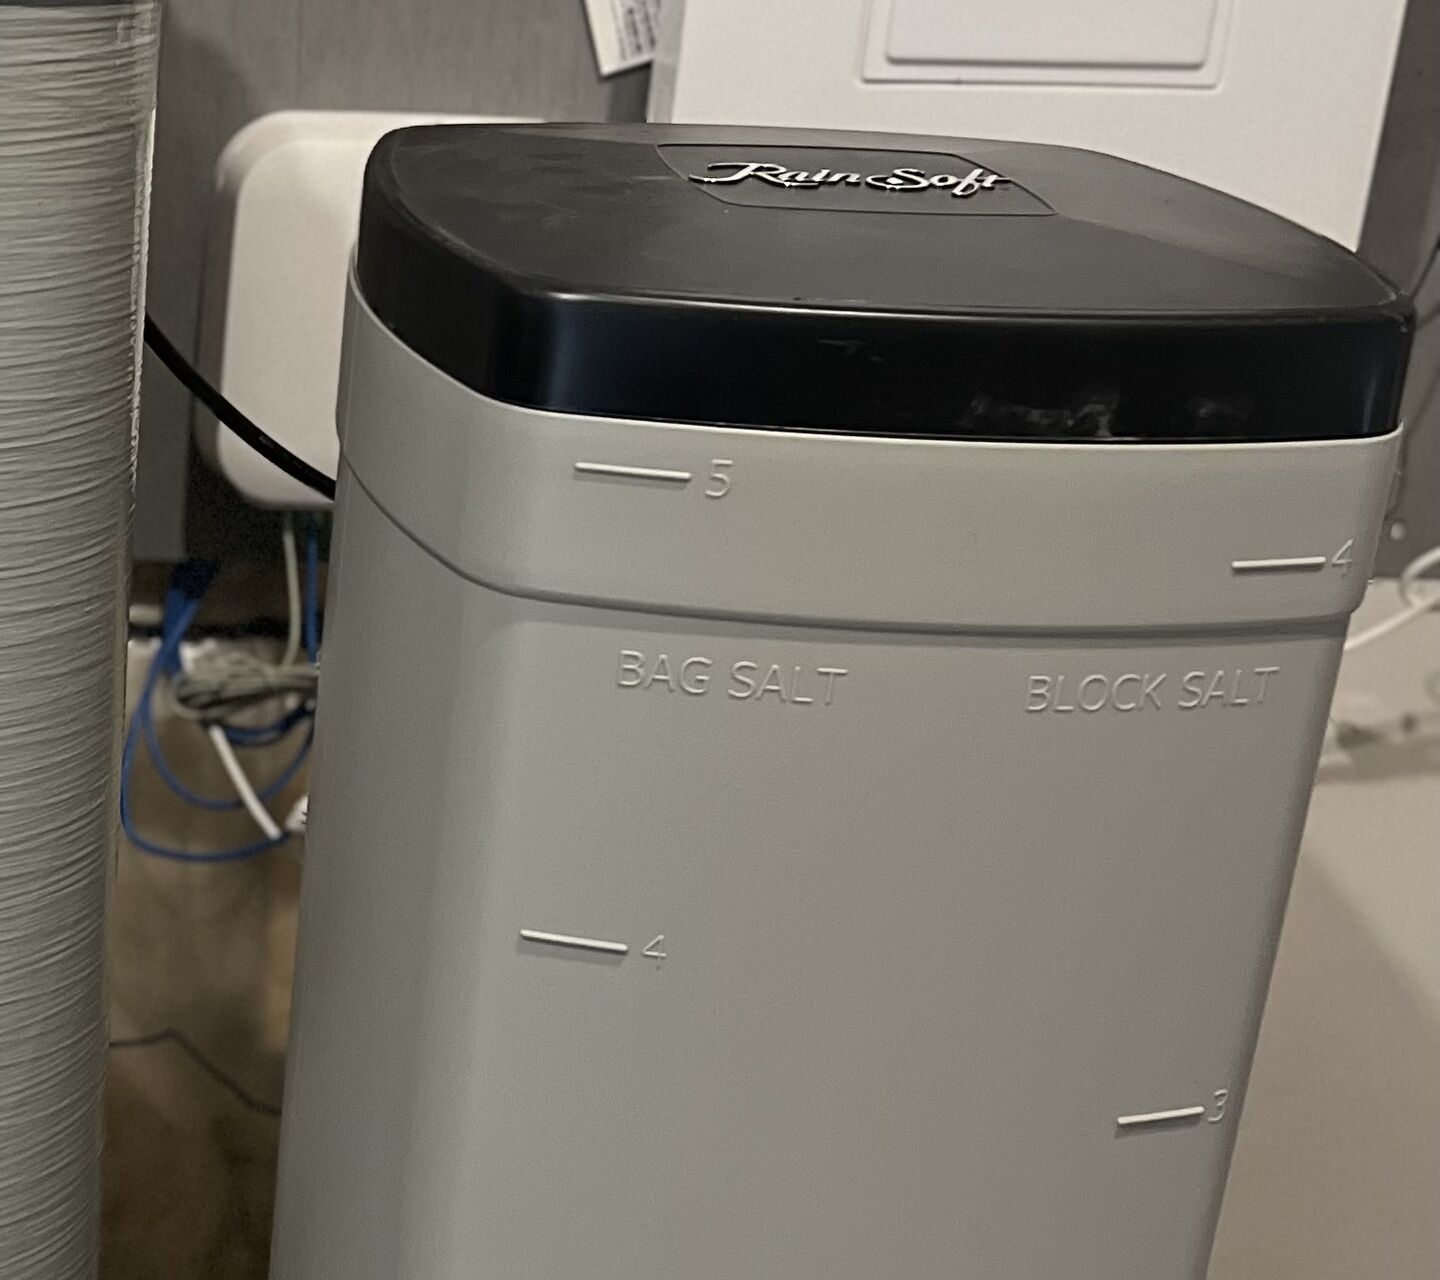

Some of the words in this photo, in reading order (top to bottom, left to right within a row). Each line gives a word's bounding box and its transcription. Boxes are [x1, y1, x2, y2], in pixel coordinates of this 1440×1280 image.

[705, 458, 734, 499] 5
[1330, 539, 1354, 578] 4
[616, 650, 713, 694] BAG
[727, 660, 850, 705] SALT
[1024, 673, 1168, 713] BLOCK
[1177, 666, 1281, 709] SALT
[642, 934, 667, 971] 4
[1208, 1088, 1229, 1123] 3
